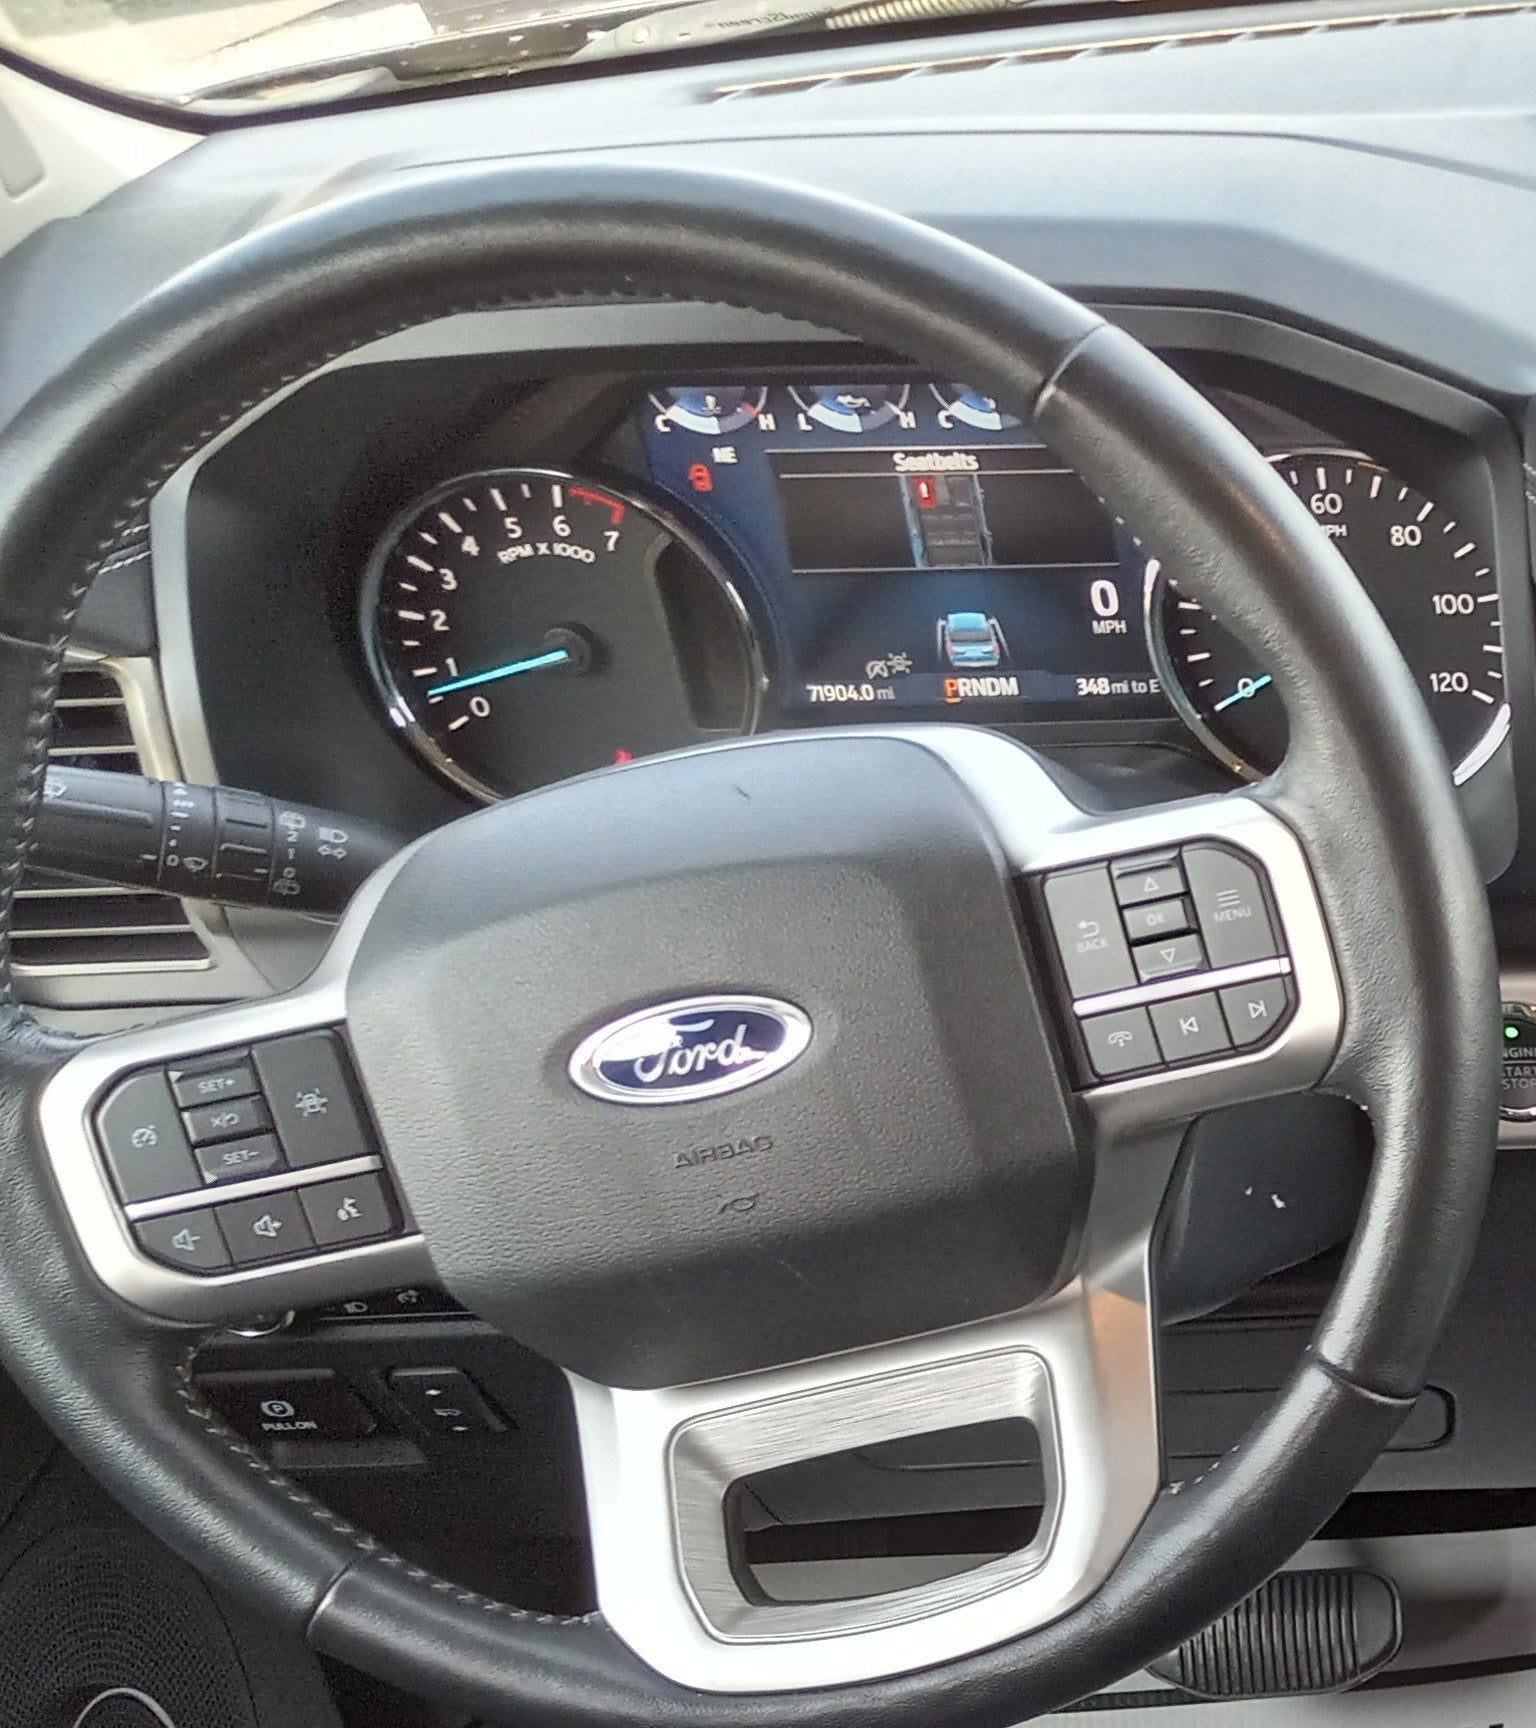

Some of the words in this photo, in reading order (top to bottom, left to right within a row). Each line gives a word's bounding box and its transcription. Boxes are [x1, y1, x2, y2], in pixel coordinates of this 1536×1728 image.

[655, 413, 671, 432] C
[758, 412, 776, 431] H
[797, 412, 813, 431] L
[899, 411, 917, 429] H
[938, 410, 953, 429] C
[892, 452, 980, 472] Seatbelts
[1309, 493, 1343, 514] 60
[504, 517, 523, 539] 5
[552, 515, 572, 537] 6
[1389, 525, 1422, 546] 80
[460, 535, 481, 557] 4
[604, 530, 620, 553] 7
[496, 541, 533, 565] RPM
[551, 541, 597, 564] 1000
[440, 568, 458, 590] 3
[1090, 579, 1120, 617] 0
[1431, 593, 1475, 615] 100
[429, 609, 450, 632] 2
[1091, 619, 1128, 635] MPH
[445, 656, 458, 677] 1
[943, 677, 1020, 699] PRNDM
[1076, 676, 1111, 697] 348
[1111, 679, 1130, 694] mi
[1131, 680, 1147, 693] to
[1237, 677, 1256, 698] 0
[1429, 671, 1469, 693] 120
[806, 684, 875, 703] 71904.0
[876, 685, 896, 701] mi
[469, 697, 491, 719] 0
[287, 831, 298, 843] 2
[166, 854, 180, 867] 0
[1146, 911, 1167, 927] OK
[1213, 904, 1253, 924] MENU
[1075, 935, 1109, 954] BACK
[633, 1018, 750, 1083] Ford
[673, 1135, 774, 1170] AIRBAG
